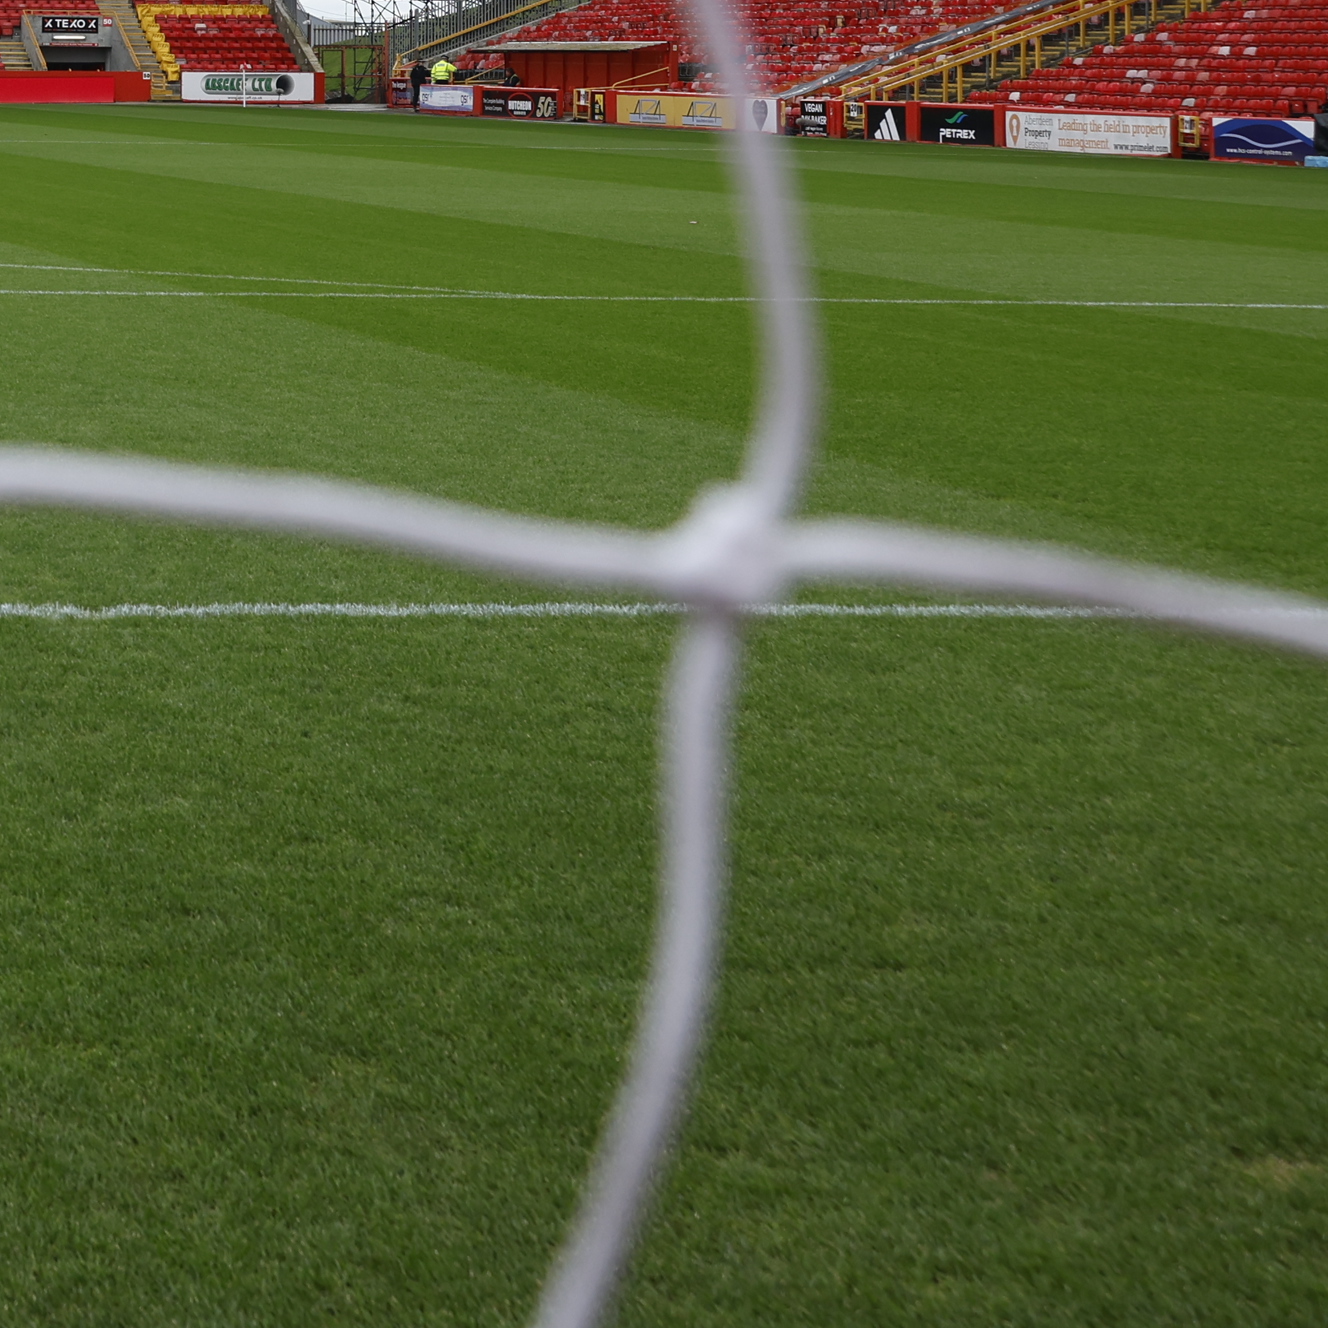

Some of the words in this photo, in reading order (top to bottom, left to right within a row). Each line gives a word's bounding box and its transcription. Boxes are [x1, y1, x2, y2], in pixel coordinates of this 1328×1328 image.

[55, 18, 86, 29] TEXO
[251, 77, 273, 92] LTD
[804, 103, 823, 113] VEGAN
[1024, 127, 1052, 140] Property
[1058, 118, 1088, 135] Leading
[1089, 120, 1102, 132] the
[1103, 120, 1121, 133] field
[1122, 121, 1131, 134] in
[1132, 123, 1168, 138] property
[939, 127, 976, 144] PETREX
[1113, 143, 1169, 153] www.primelet.com
